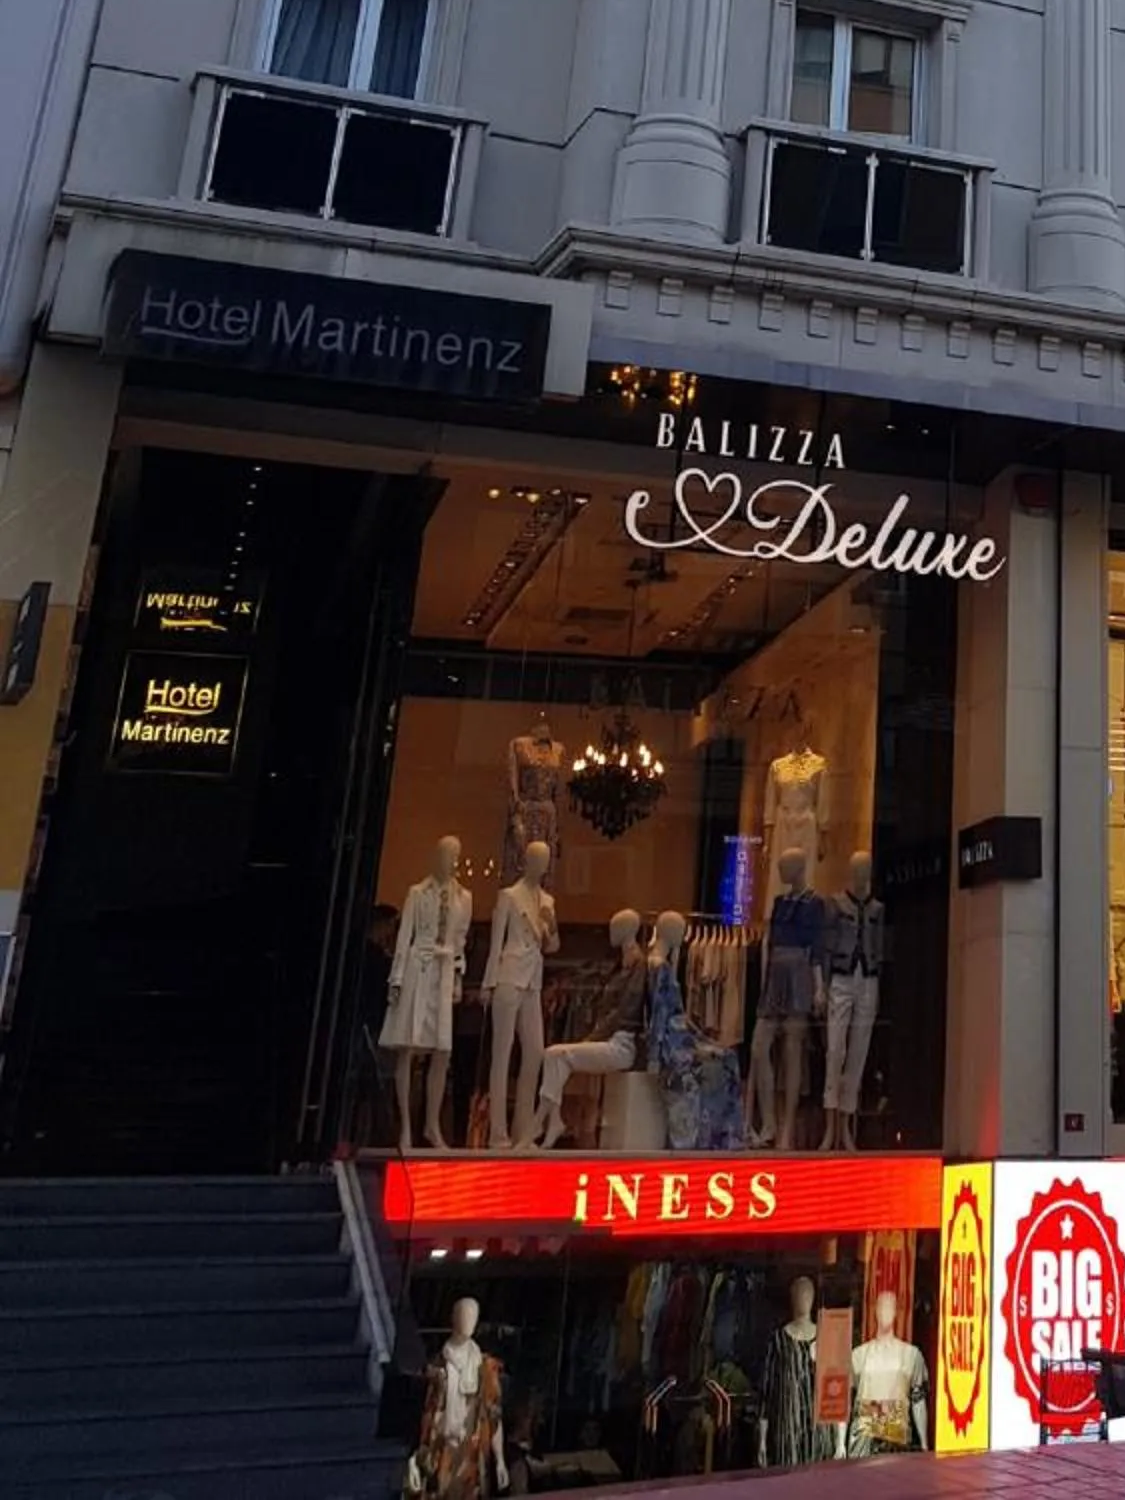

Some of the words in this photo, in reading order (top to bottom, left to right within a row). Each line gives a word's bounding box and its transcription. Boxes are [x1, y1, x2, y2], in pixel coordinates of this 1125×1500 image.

[140, 286, 262, 346] Hotel
[271, 300, 523, 373] Martinenz
[656, 413, 847, 469] BALIZZA
[144, 679, 222, 716] Hotel
[121, 719, 232, 746] Martinenz
[573, 1171, 777, 1222] iNESS
[951, 1251, 976, 1318] BIG
[1031, 1249, 1101, 1320] BIG
[949, 1321, 975, 1373] SALE
